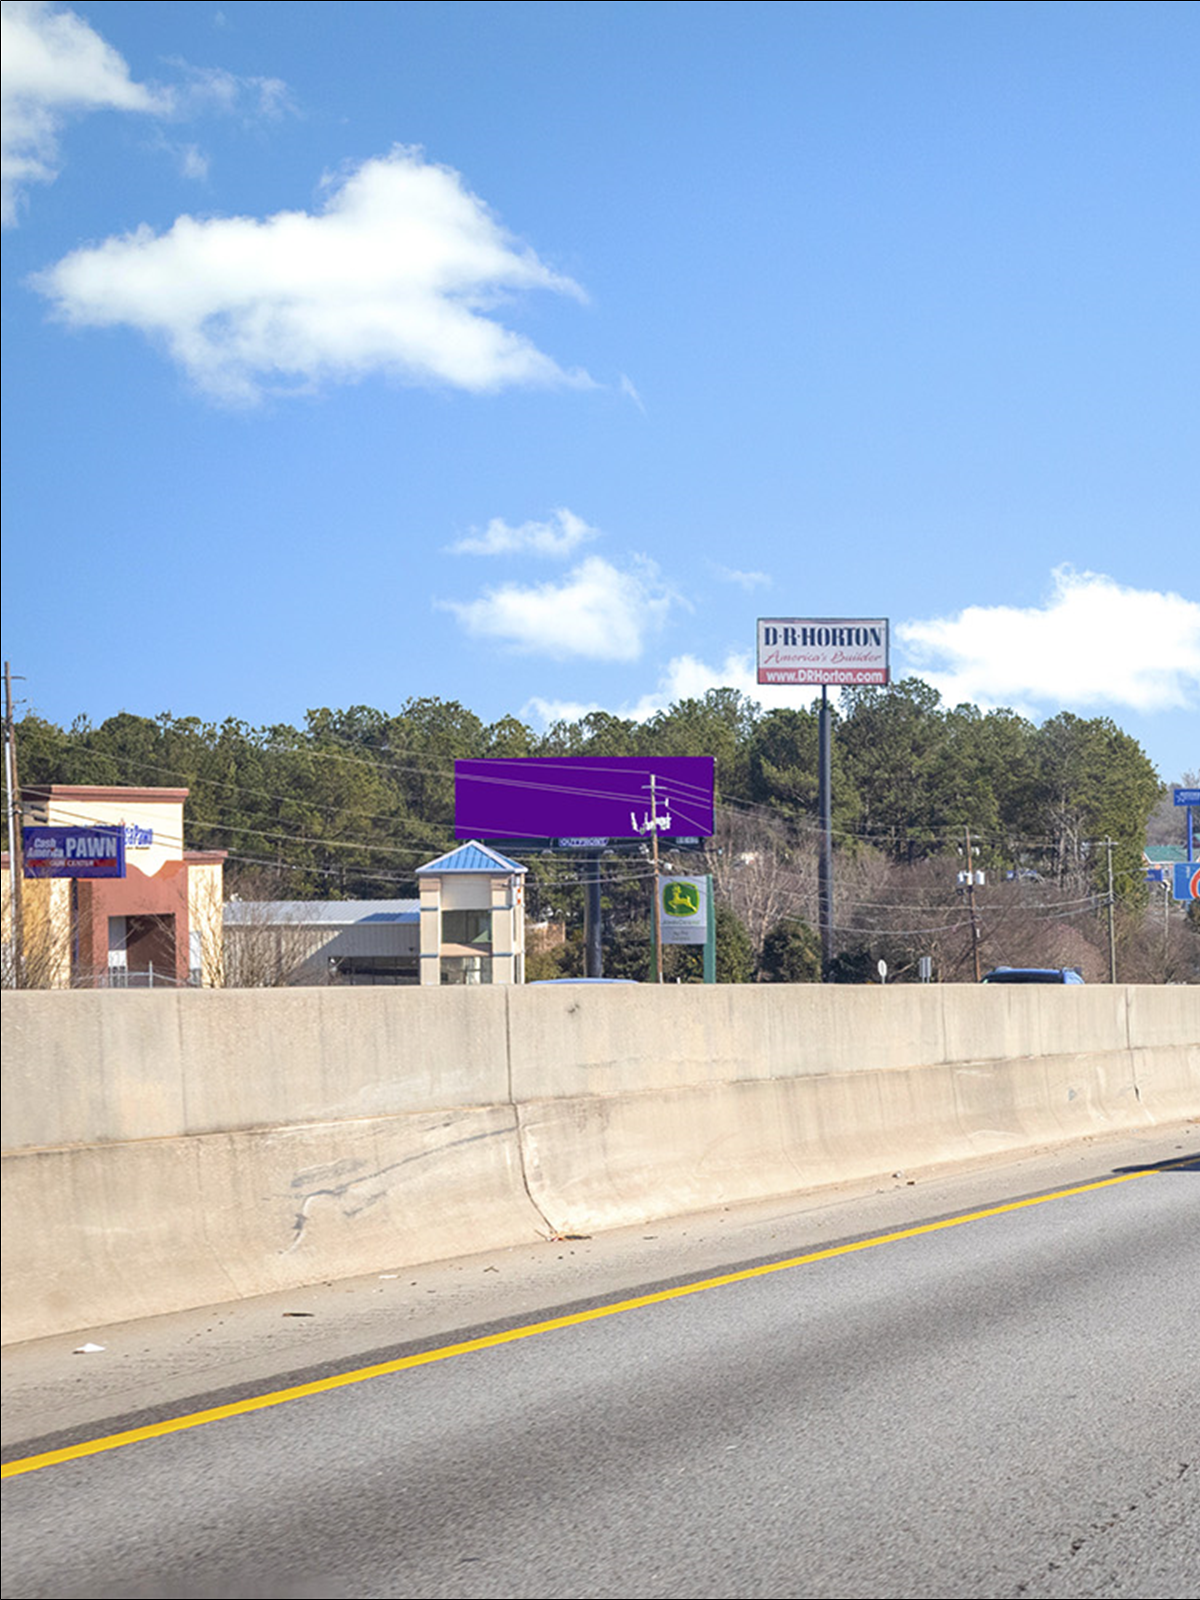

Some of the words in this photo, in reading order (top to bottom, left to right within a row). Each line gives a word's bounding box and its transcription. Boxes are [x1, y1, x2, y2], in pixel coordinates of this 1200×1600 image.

[764, 650, 827, 664] America's
[831, 650, 882, 664] Builder
[766, 669, 883, 682] www.DRHorton.com
[33, 838, 56, 848] Cash
[65, 837, 117, 858] PAWN
